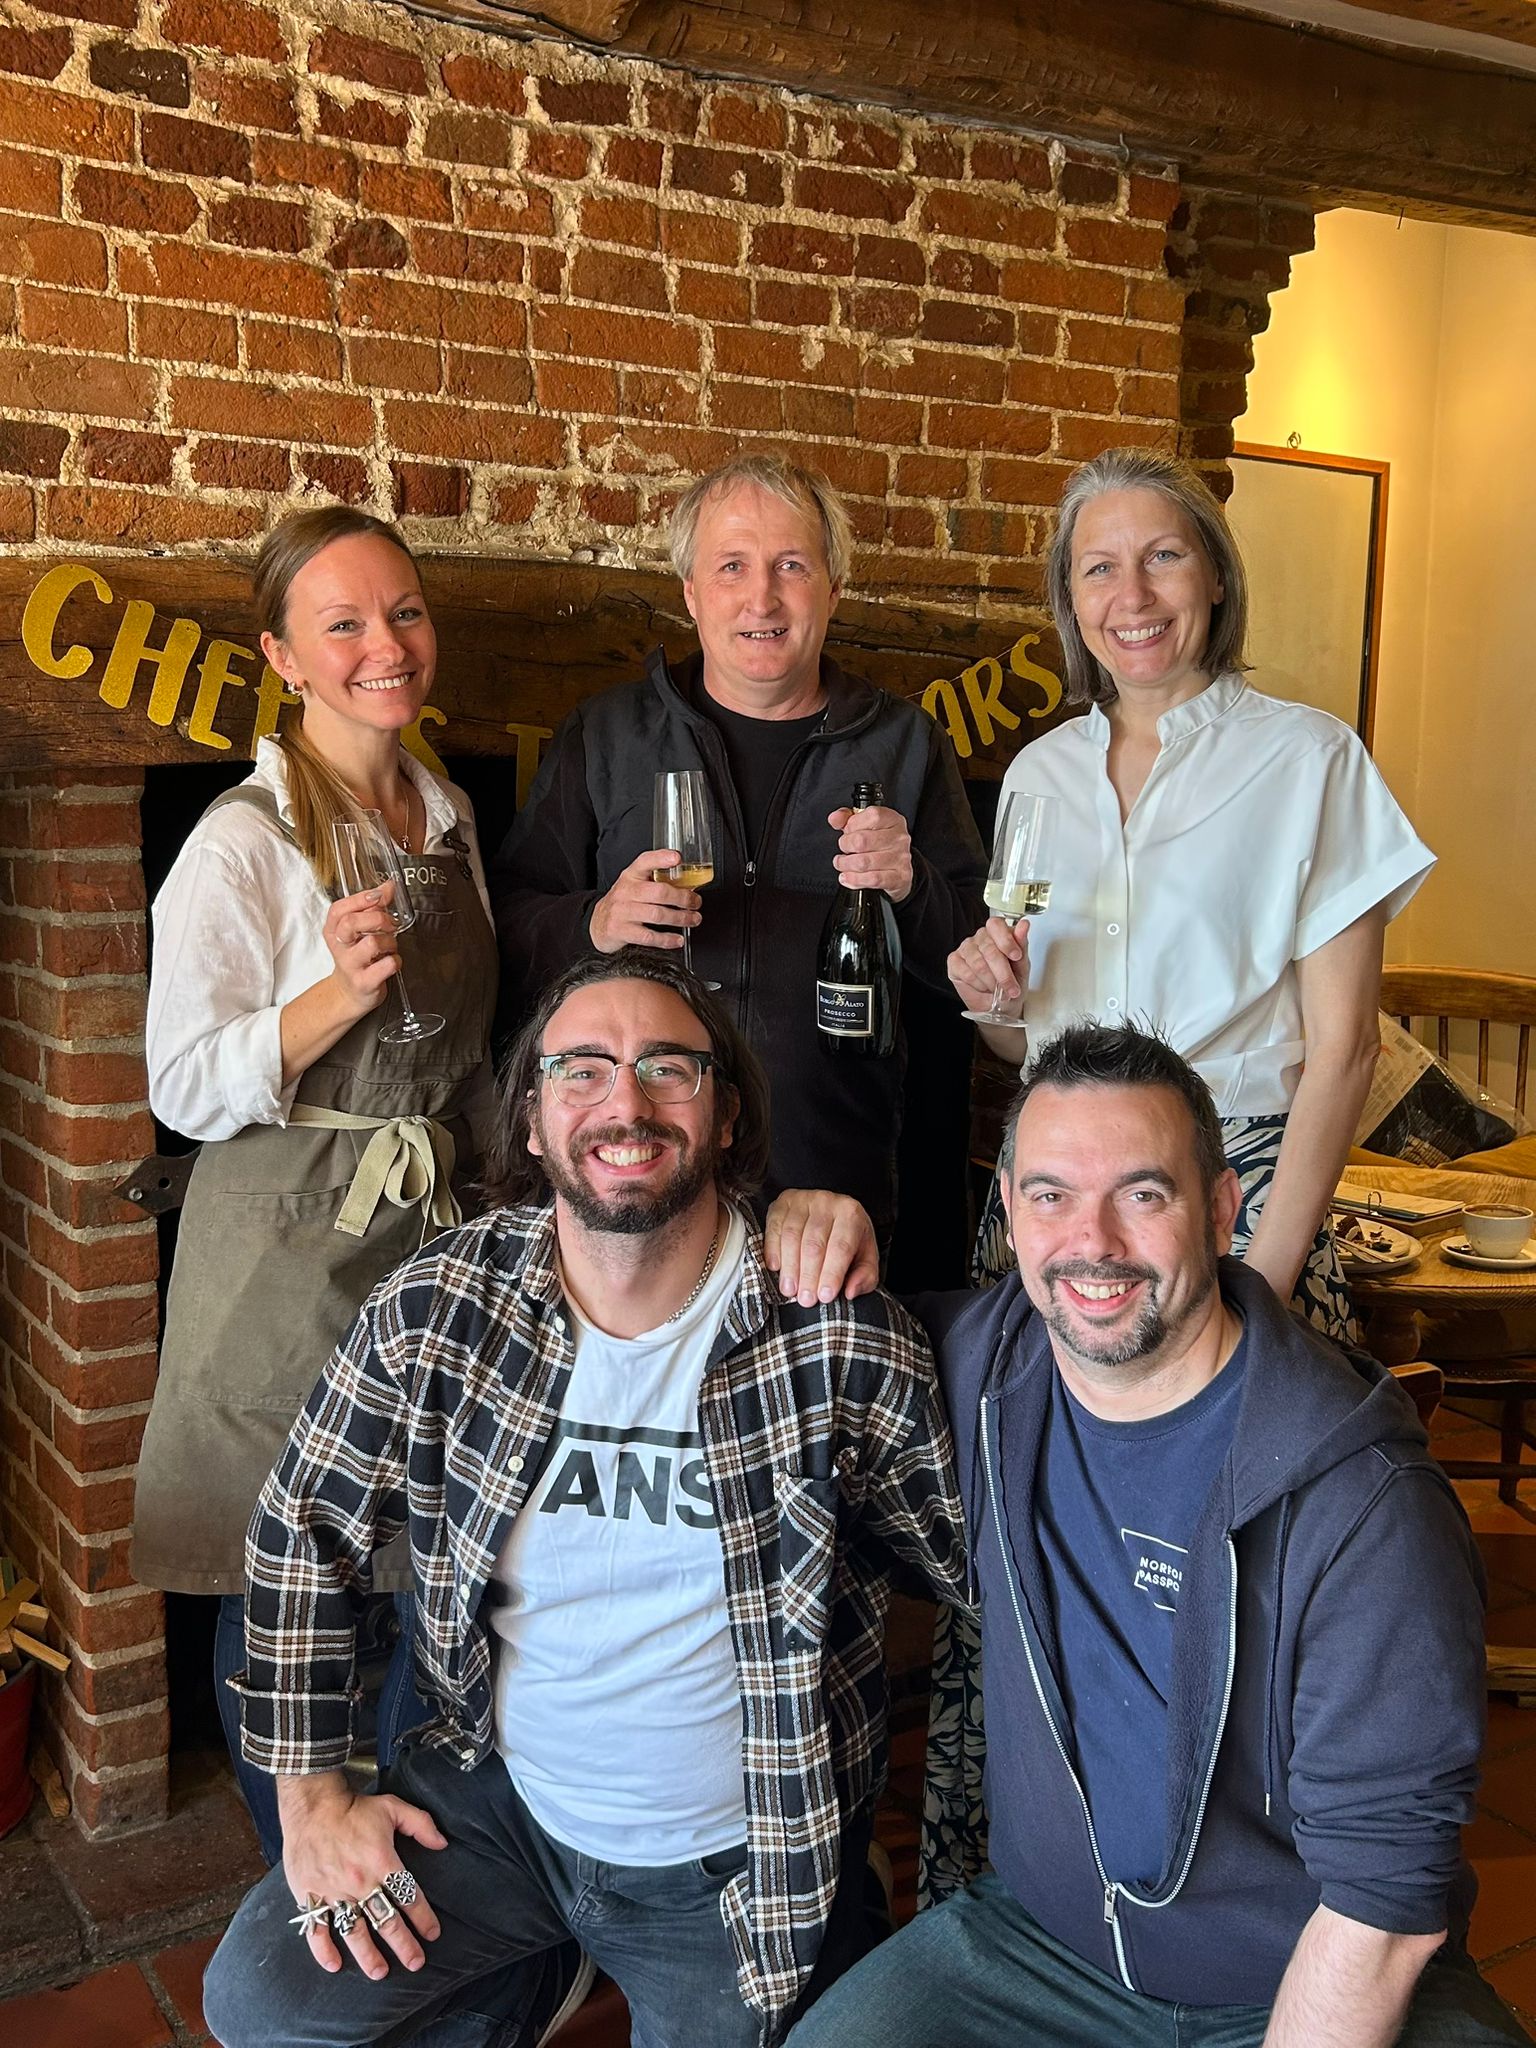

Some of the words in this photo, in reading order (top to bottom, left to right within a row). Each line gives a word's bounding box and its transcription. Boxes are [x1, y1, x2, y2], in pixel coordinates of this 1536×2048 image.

[921, 633, 1062, 758] ARS
[824, 1009, 856, 1017] PROSECCO
[1139, 1570, 1179, 1591] PASSPO
